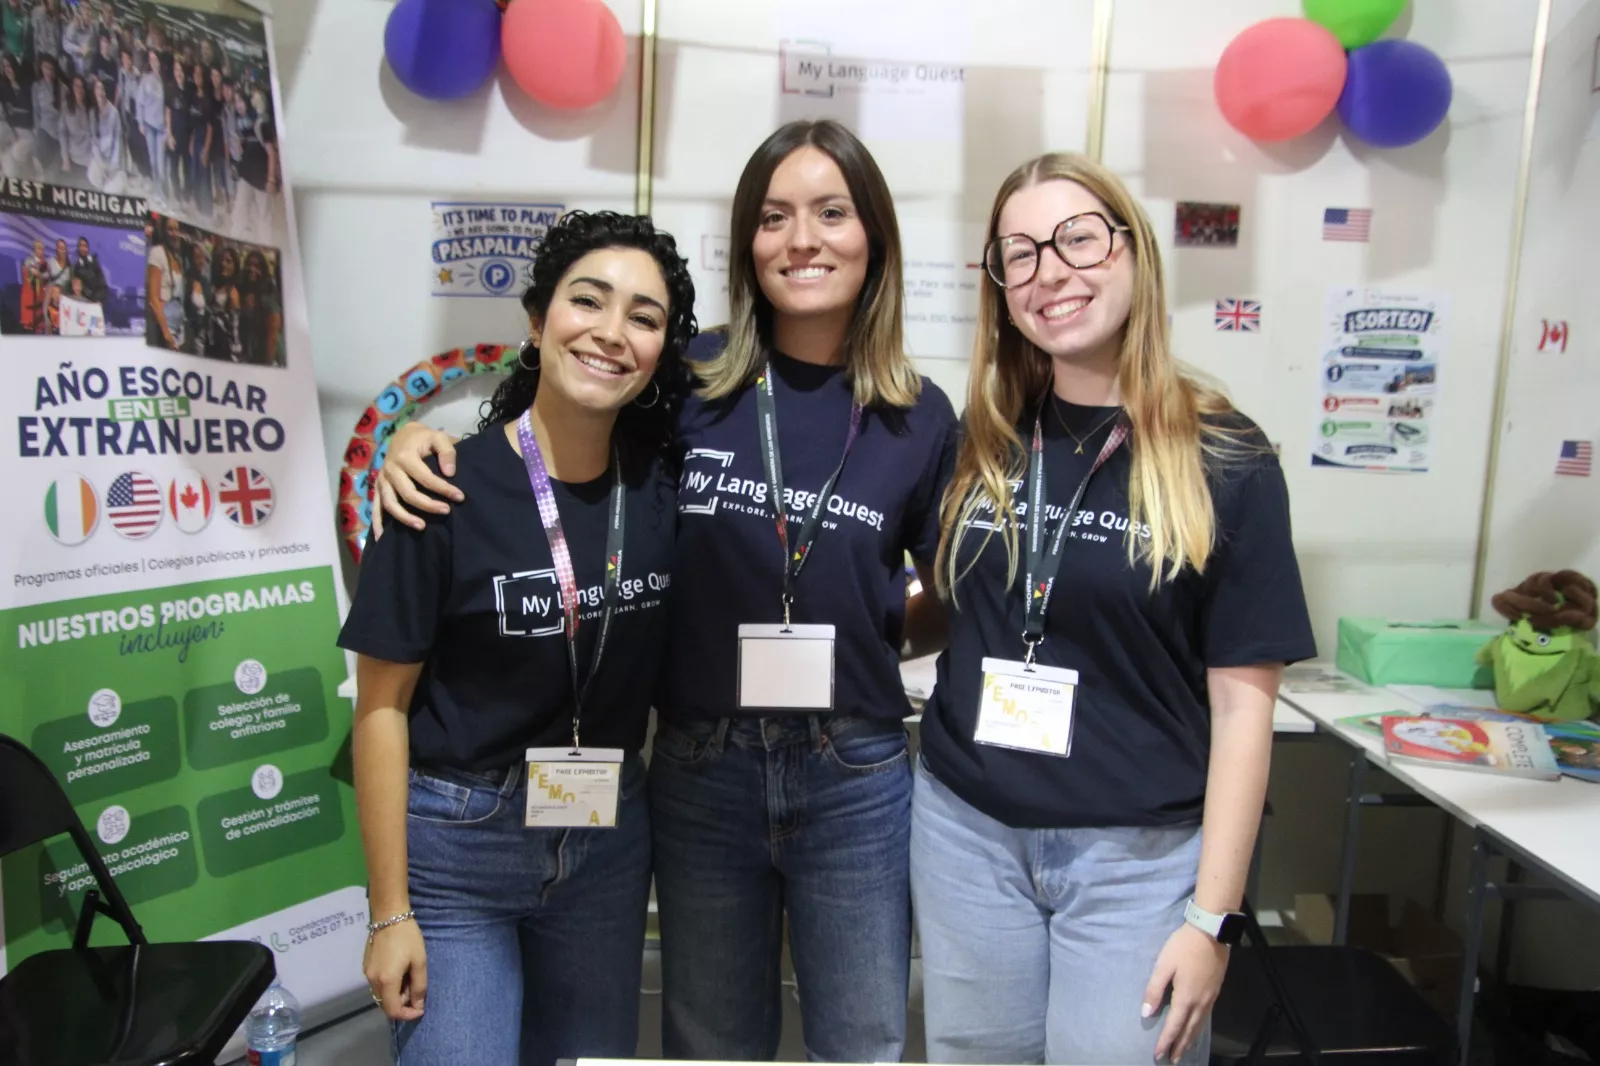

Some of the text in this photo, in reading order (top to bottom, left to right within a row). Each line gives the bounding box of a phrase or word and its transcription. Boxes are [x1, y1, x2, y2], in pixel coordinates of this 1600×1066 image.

[799, 62, 965, 83] My Language Quest
[52, 187, 149, 217] MICHIGAN
[442, 207, 557, 227] IT'S TIME TO PLAY!
[438, 238, 541, 261] PASAPALAB
[491, 268, 505, 285] P
[1347, 310, 1430, 333] ¡SORTEO!
[35, 361, 267, 414] AÑO ESCOLAR
[113, 399, 187, 419] EN EL
[18, 416, 286, 457] EXTRANJERO
[686, 472, 885, 531] My Langage Quest
[1081, 532, 1108, 543] GROW
[1100, 511, 1152, 538] Ques
[14, 568, 82, 588] Programas
[84, 561, 139, 578] oficiales
[147, 555, 194, 570] Colegios
[248, 550, 256, 561] y
[258, 542, 310, 559] privados
[18, 581, 316, 649] NUESTROS PROGRAMAS
[522, 595, 551, 616] My
[641, 600, 661, 609] GROW
[119, 615, 225, 663] incluyen:
[209, 703, 301, 731] colegio y familia
[217, 693, 290, 716] Selección de
[63, 724, 151, 753] Asesoramiento
[230, 719, 286, 739] anfitriona
[66, 751, 151, 783] personalizada
[74, 754, 82, 767] y
[529, 764, 600, 826] FEMOA
[221, 794, 320, 828] Gestión y trámites
[225, 806, 320, 840] de convalidación
[44, 830, 190, 885] Seguimnto académico
[58, 847, 179, 898] y apo psicológico
